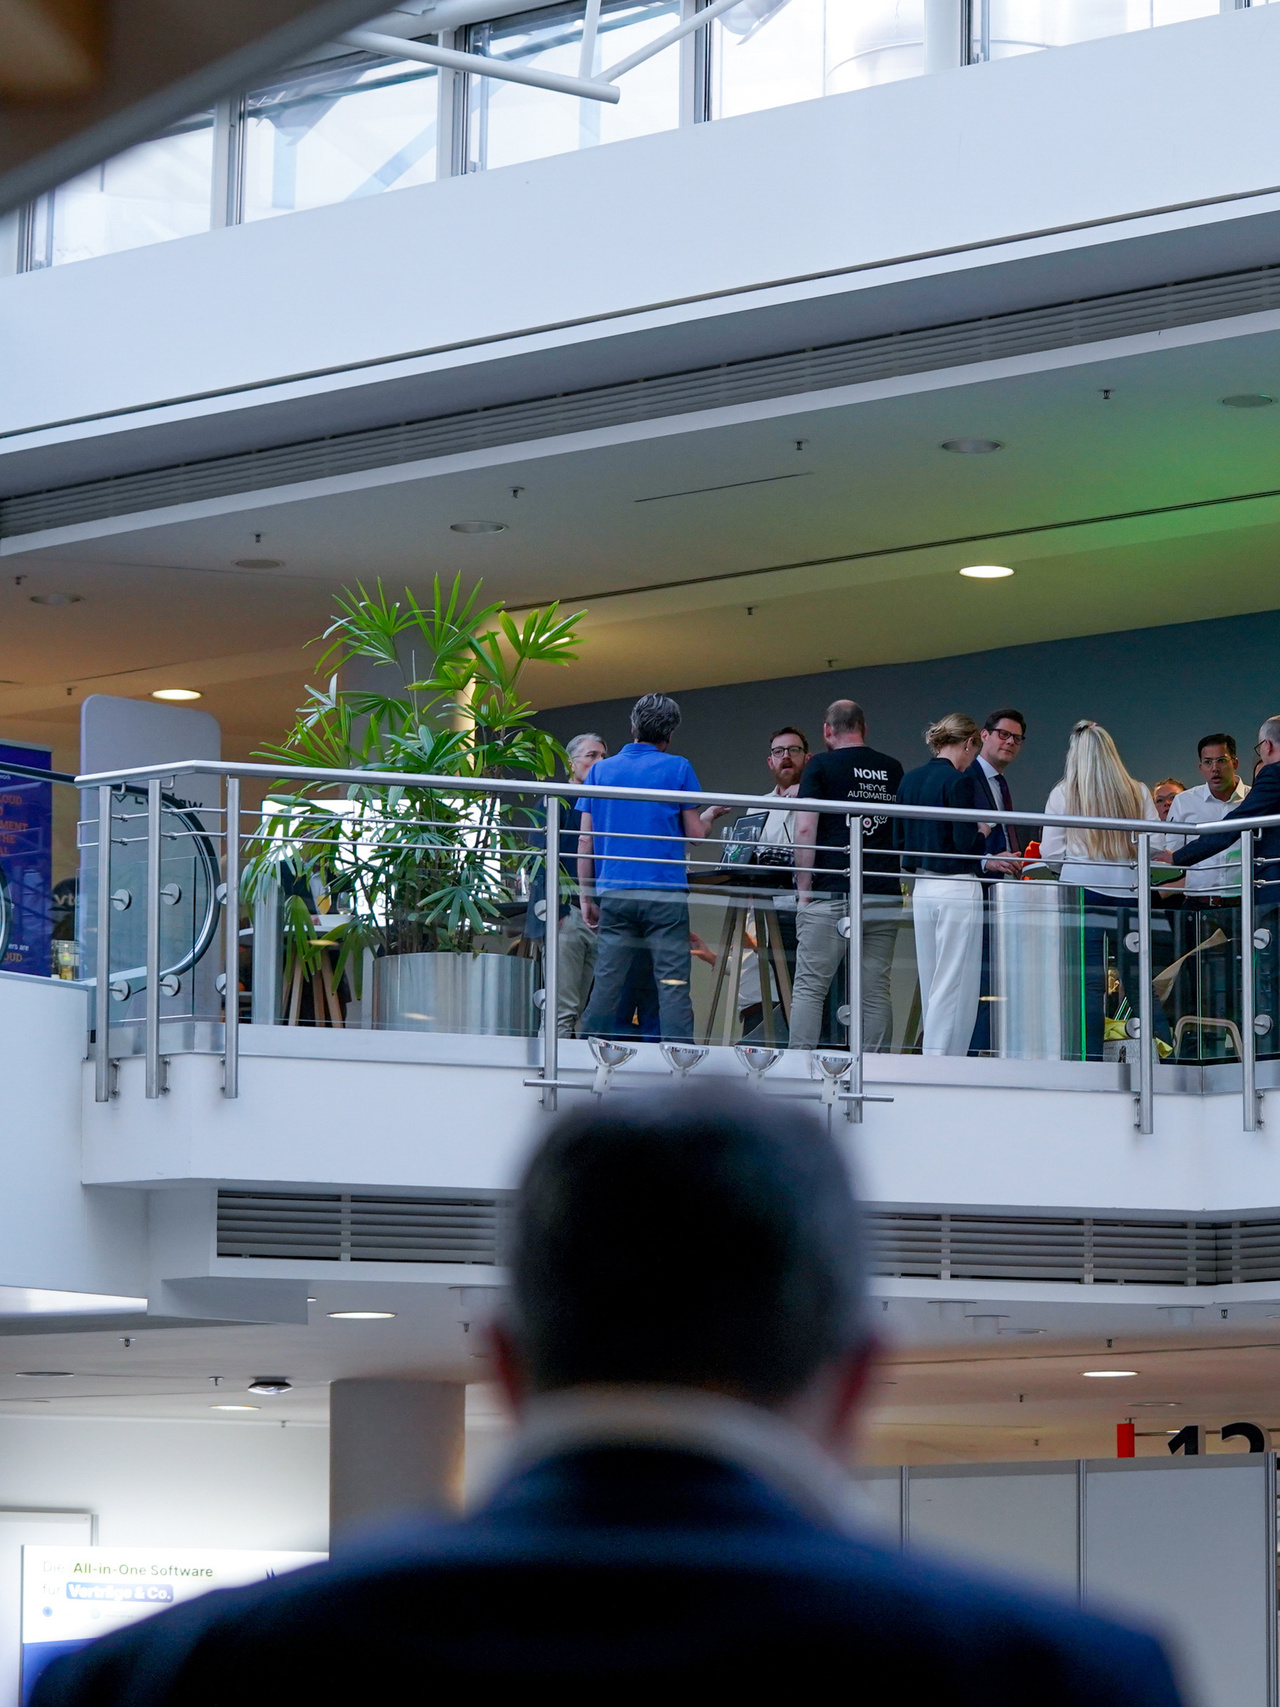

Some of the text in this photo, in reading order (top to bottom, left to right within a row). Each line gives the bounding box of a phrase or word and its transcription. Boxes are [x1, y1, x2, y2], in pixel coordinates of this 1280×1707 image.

[853, 767, 889, 781] NONE
[847, 790, 892, 802] AUTOMATED
[73, 1562, 147, 1576] All-in-One
[151, 1564, 213, 1578] Software
[68, 1584, 132, 1602] Verträge
[134, 1587, 144, 1599] &
[147, 1587, 171, 1600] Co.
